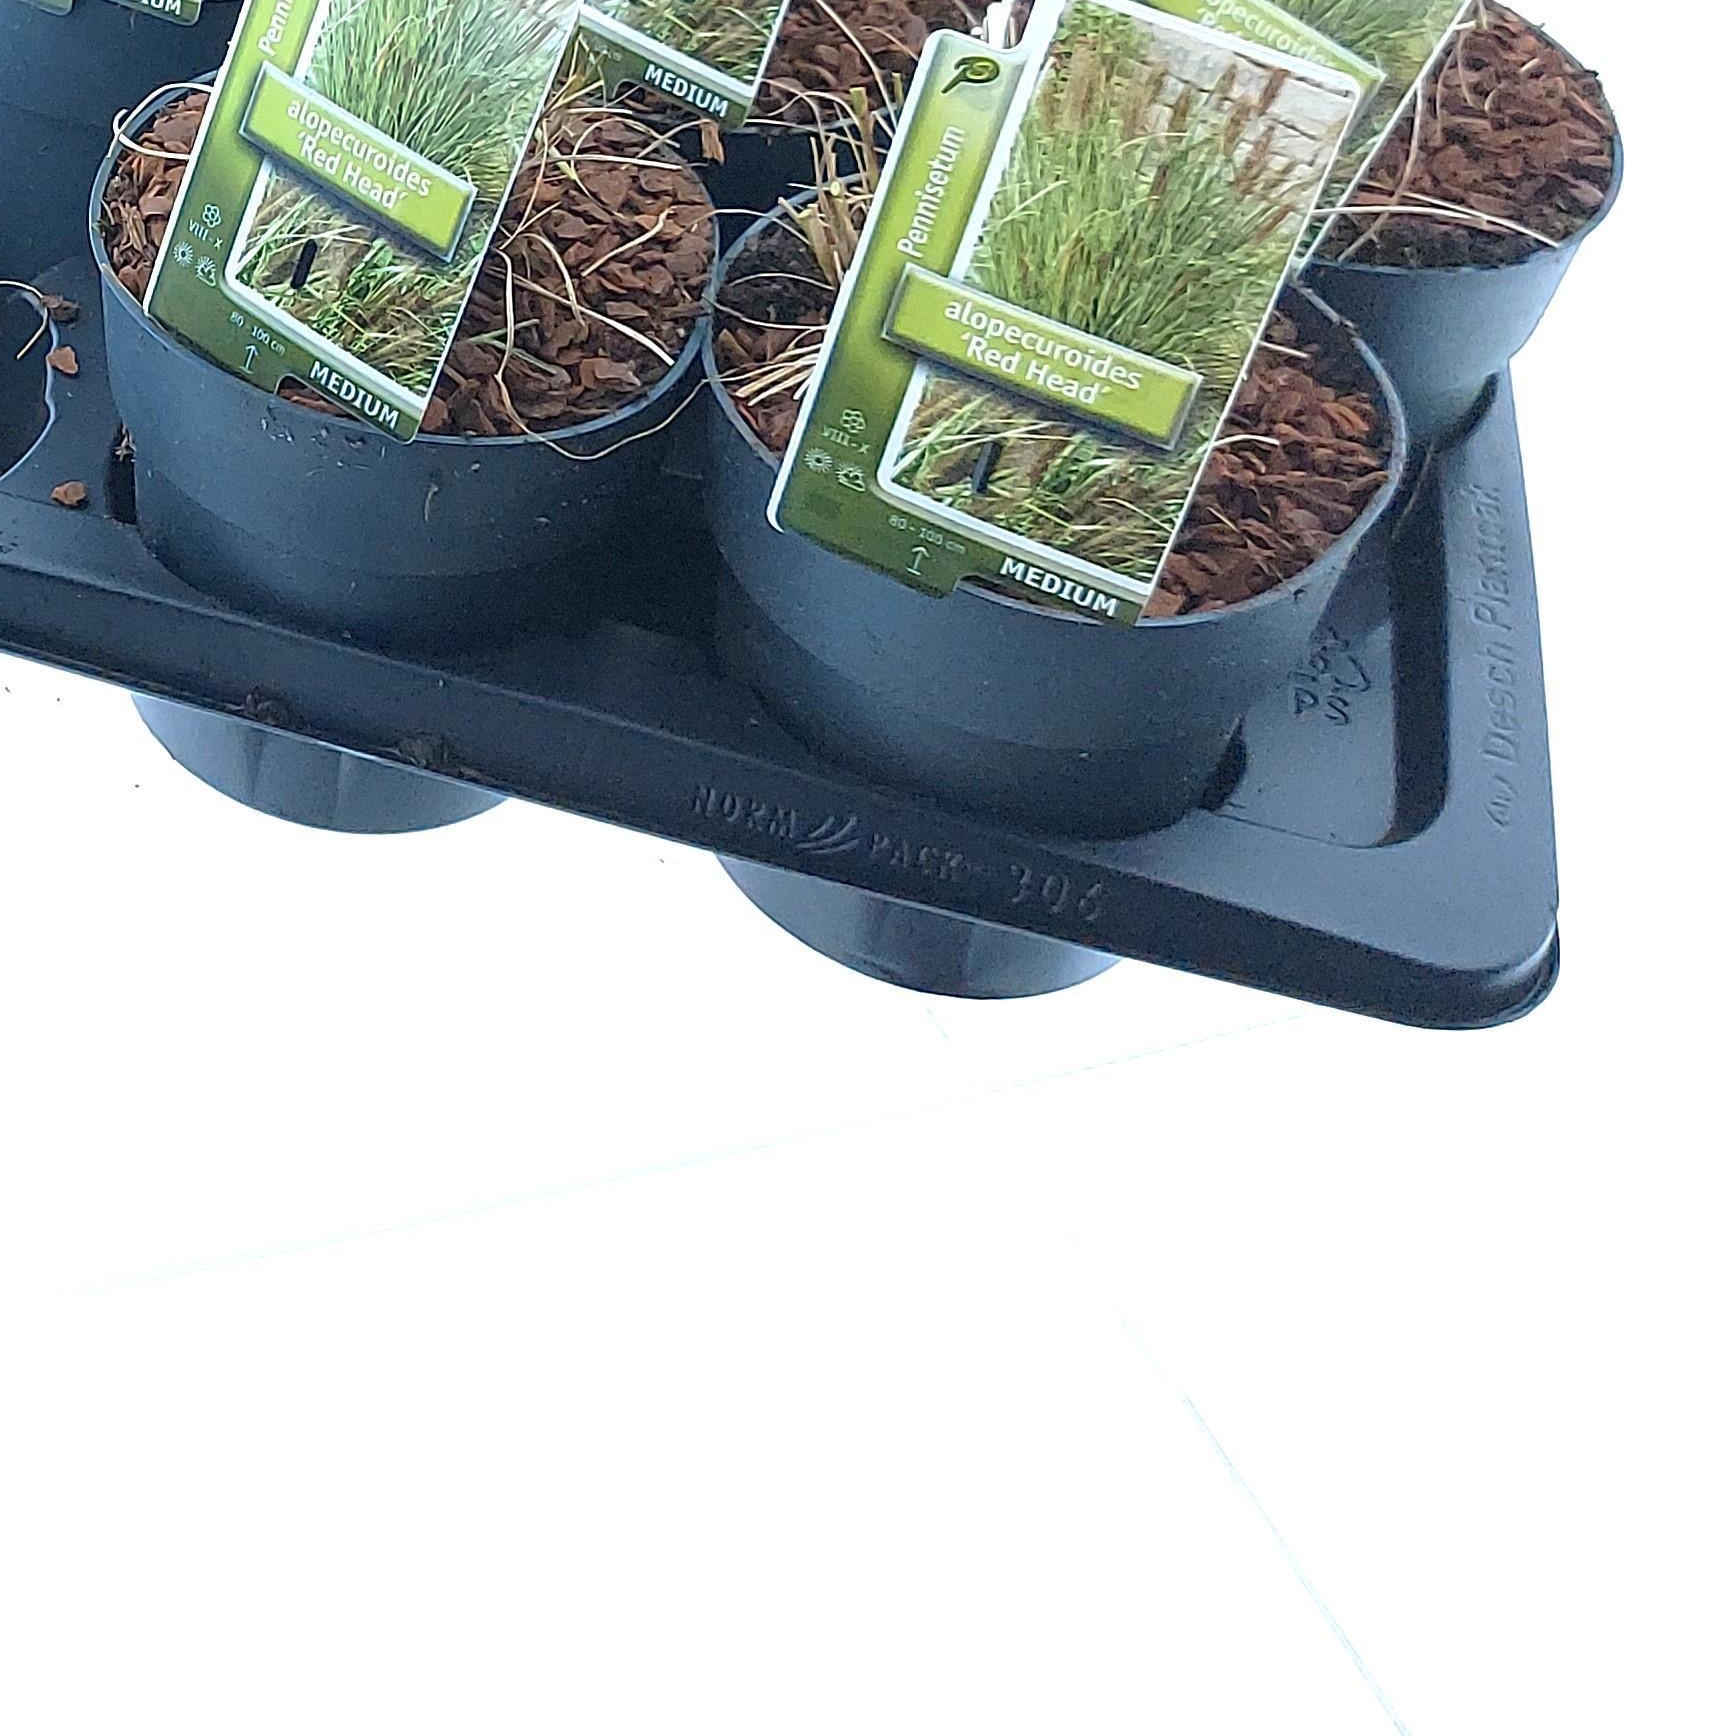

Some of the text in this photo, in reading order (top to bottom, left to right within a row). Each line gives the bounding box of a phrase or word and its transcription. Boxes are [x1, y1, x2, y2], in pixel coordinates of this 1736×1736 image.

[645, 64, 729, 118] MEDIUM
[287, 98, 432, 197] alopecuroides
[897, 126, 966, 258] Pennisetum
[944, 301, 1143, 390] alopecuroides
[310, 360, 399, 430] MEDIUM
[1000, 556, 1118, 617] MEDIUM
